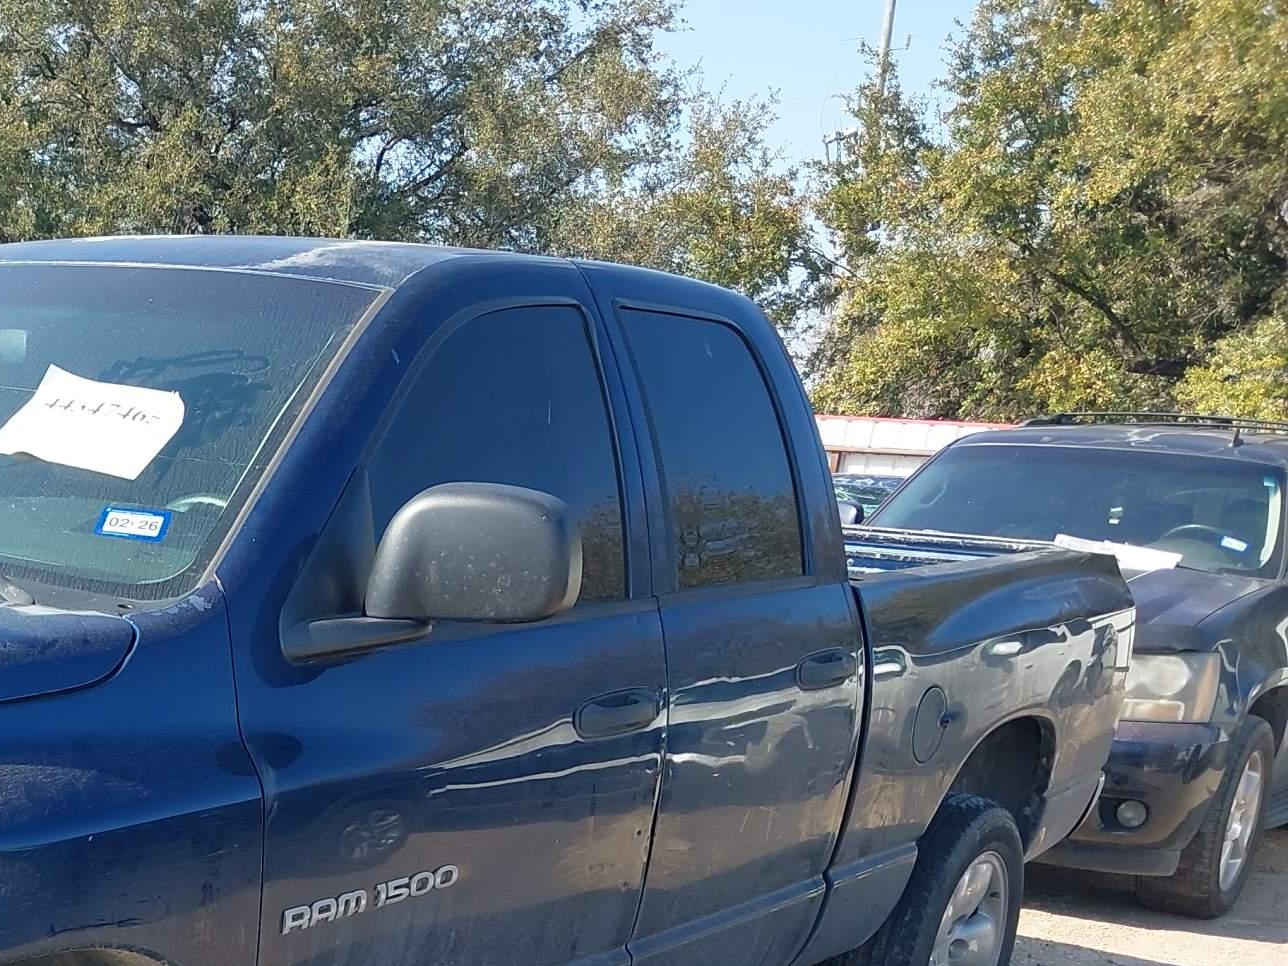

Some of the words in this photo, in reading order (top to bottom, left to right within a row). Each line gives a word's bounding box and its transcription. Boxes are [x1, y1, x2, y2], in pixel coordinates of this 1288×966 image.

[108, 517, 130, 528] 02
[137, 520, 159, 531] 26
[282, 889, 367, 935] RAM
[375, 864, 459, 908] 1500
